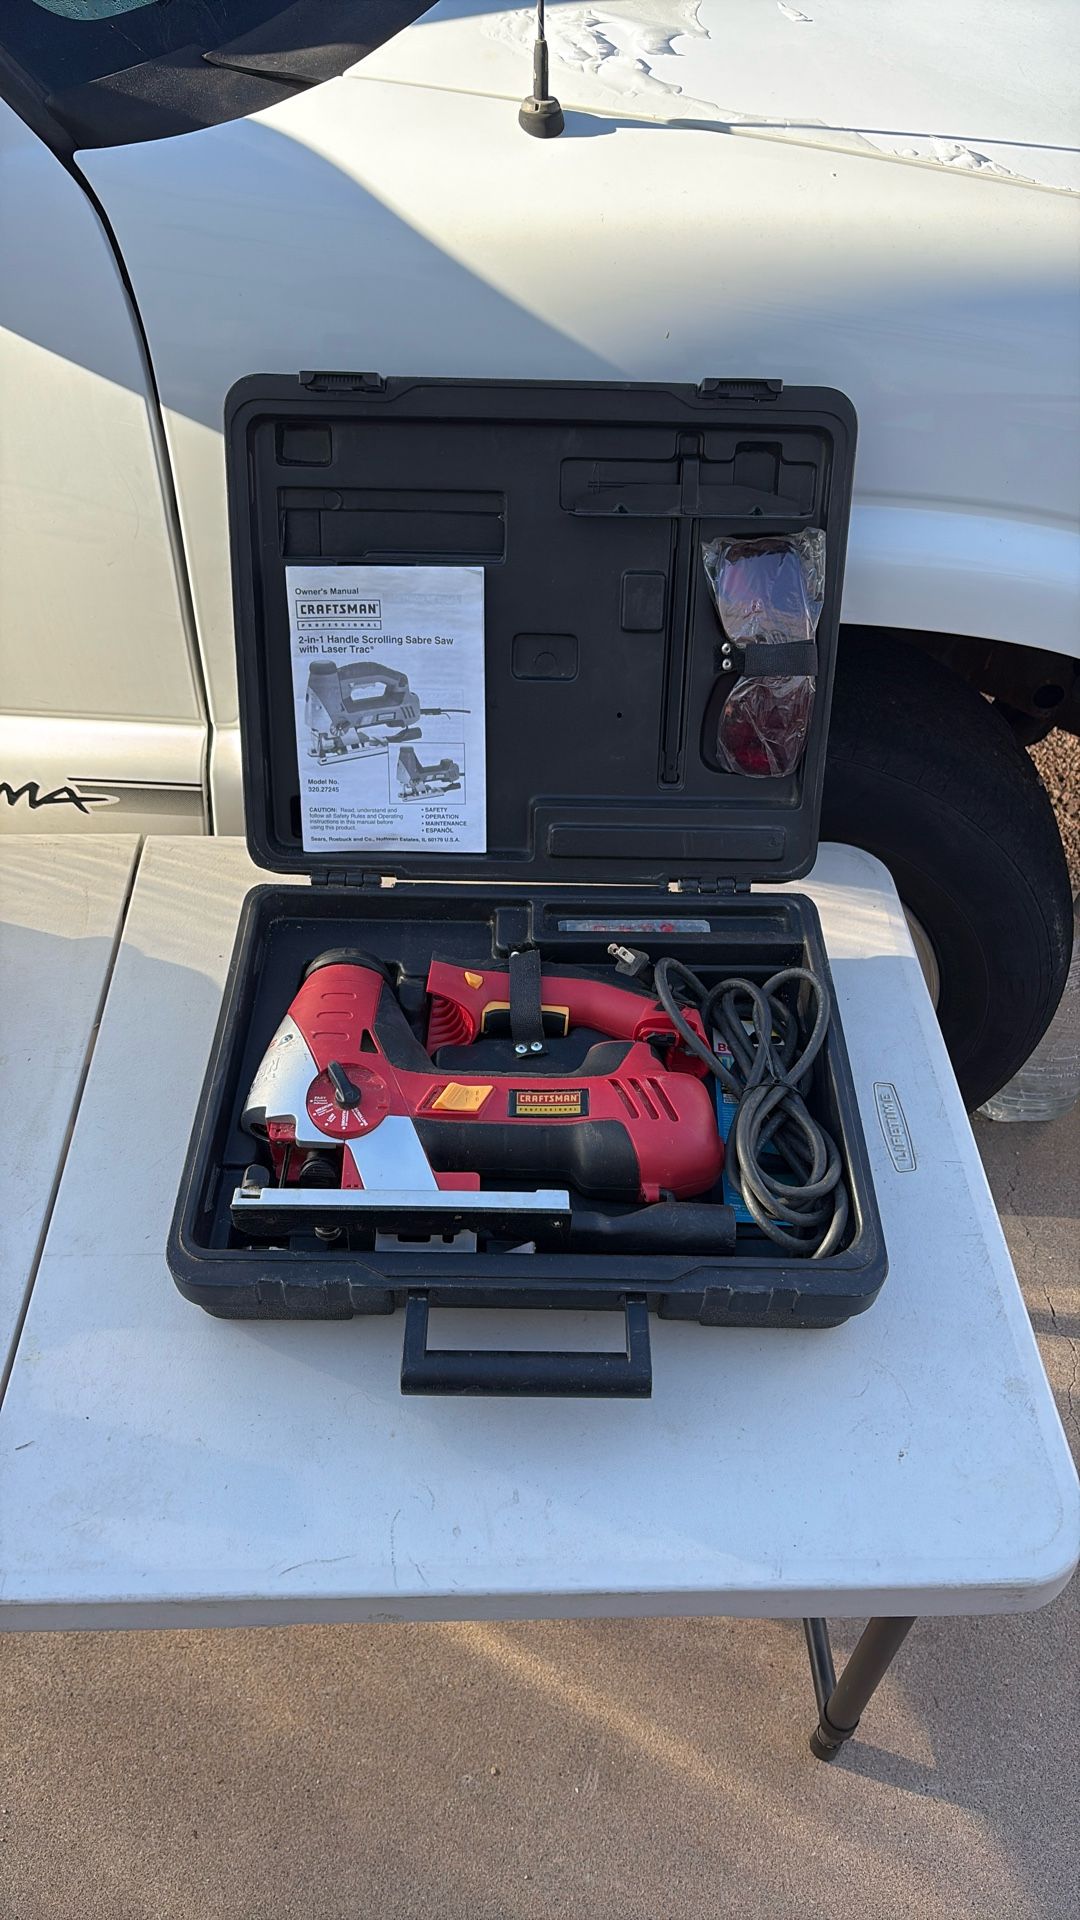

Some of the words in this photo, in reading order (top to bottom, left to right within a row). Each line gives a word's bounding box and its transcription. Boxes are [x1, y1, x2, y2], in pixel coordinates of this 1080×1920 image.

[295, 587, 328, 596] Owner's
[330, 587, 359, 595] Manual
[298, 635, 324, 644] 2-in-1
[327, 635, 359, 644] Handle
[361, 635, 403, 645] Scrolling
[405, 635, 432, 644] Sabre
[434, 636, 454, 645] Saw
[299, 645, 319, 653] with
[321, 645, 347, 653] Laser
[880, 1093, 907, 1161] LIFETIME
